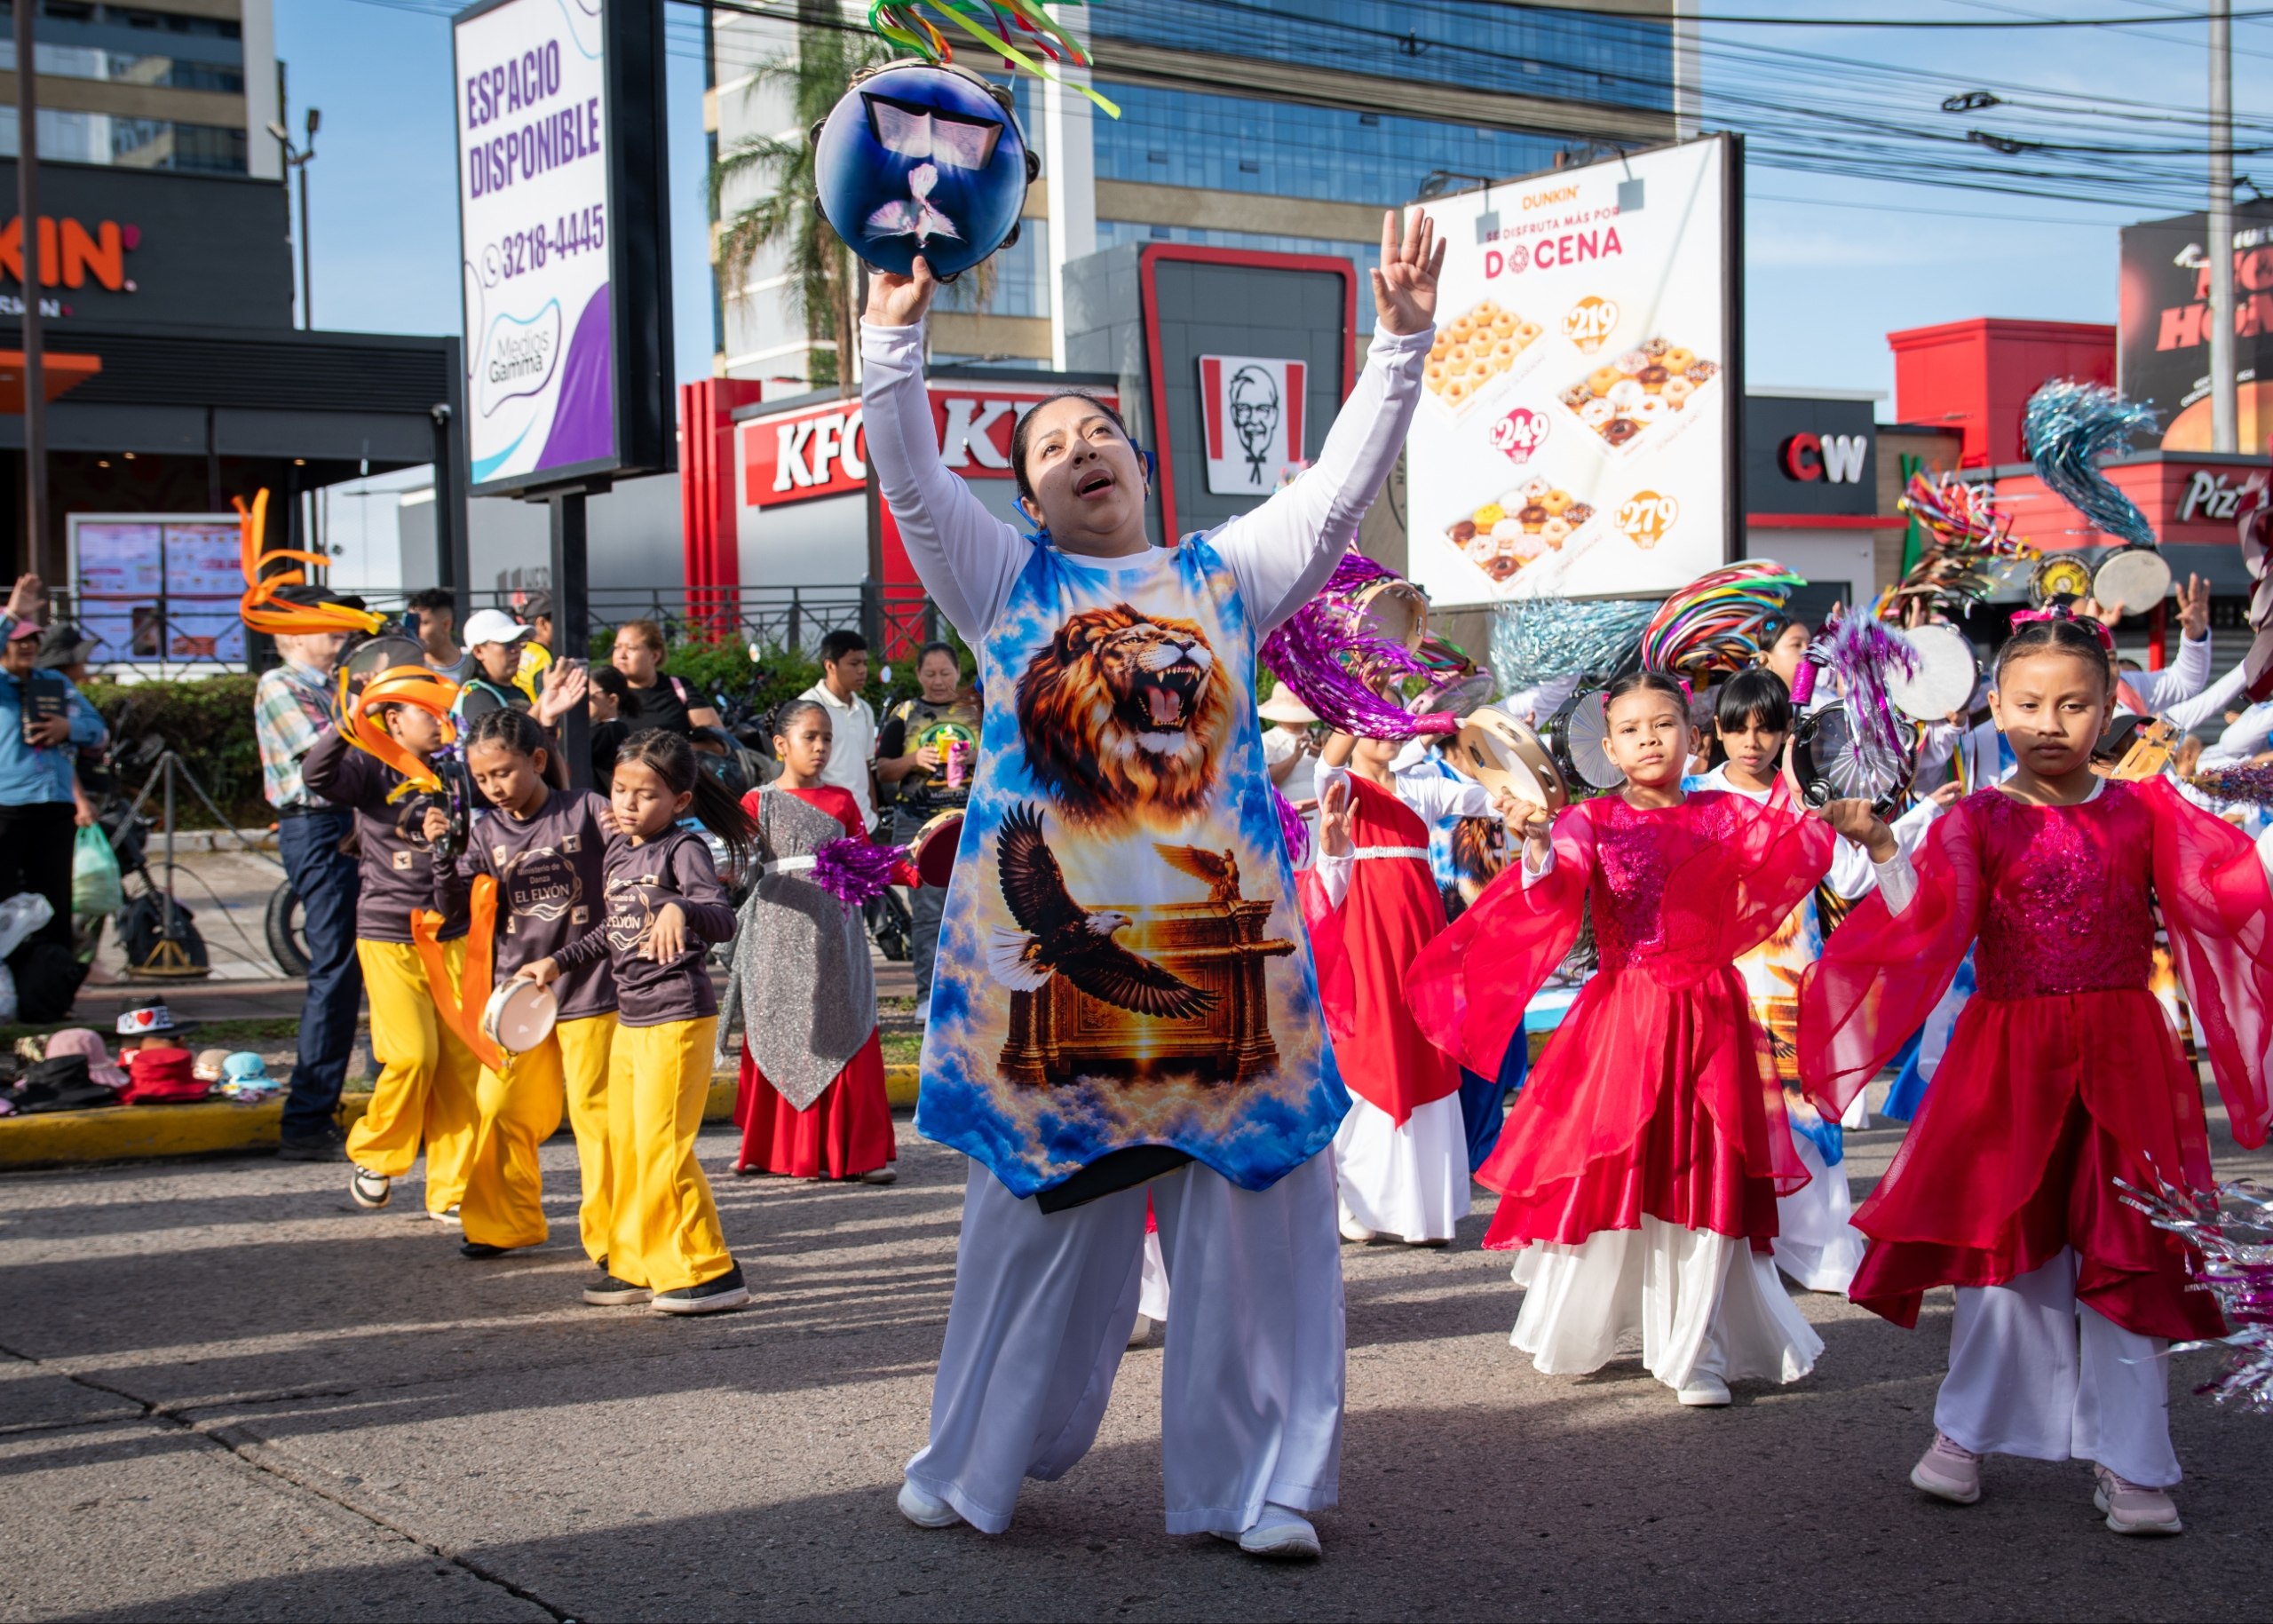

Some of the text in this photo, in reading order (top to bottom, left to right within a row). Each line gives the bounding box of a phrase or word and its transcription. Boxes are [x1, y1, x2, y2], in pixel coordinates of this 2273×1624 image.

[466, 39, 560, 130] ESPACIO
[470, 97, 600, 200] DISPONIBLE
[503, 203, 604, 279] 3218-4445
[1503, 219, 1560, 240] DISFRUTA
[1564, 211, 1589, 226] MÁS
[1485, 226, 1622, 280] DOCENA
[497, 329, 550, 360] Medios
[489, 354, 543, 384] Gamma
[1786, 432, 1867, 484] CW
[517, 864, 550, 875] Ministerio
[529, 875, 550, 884] Danza
[514, 882, 570, 904] EL ELYÓN
